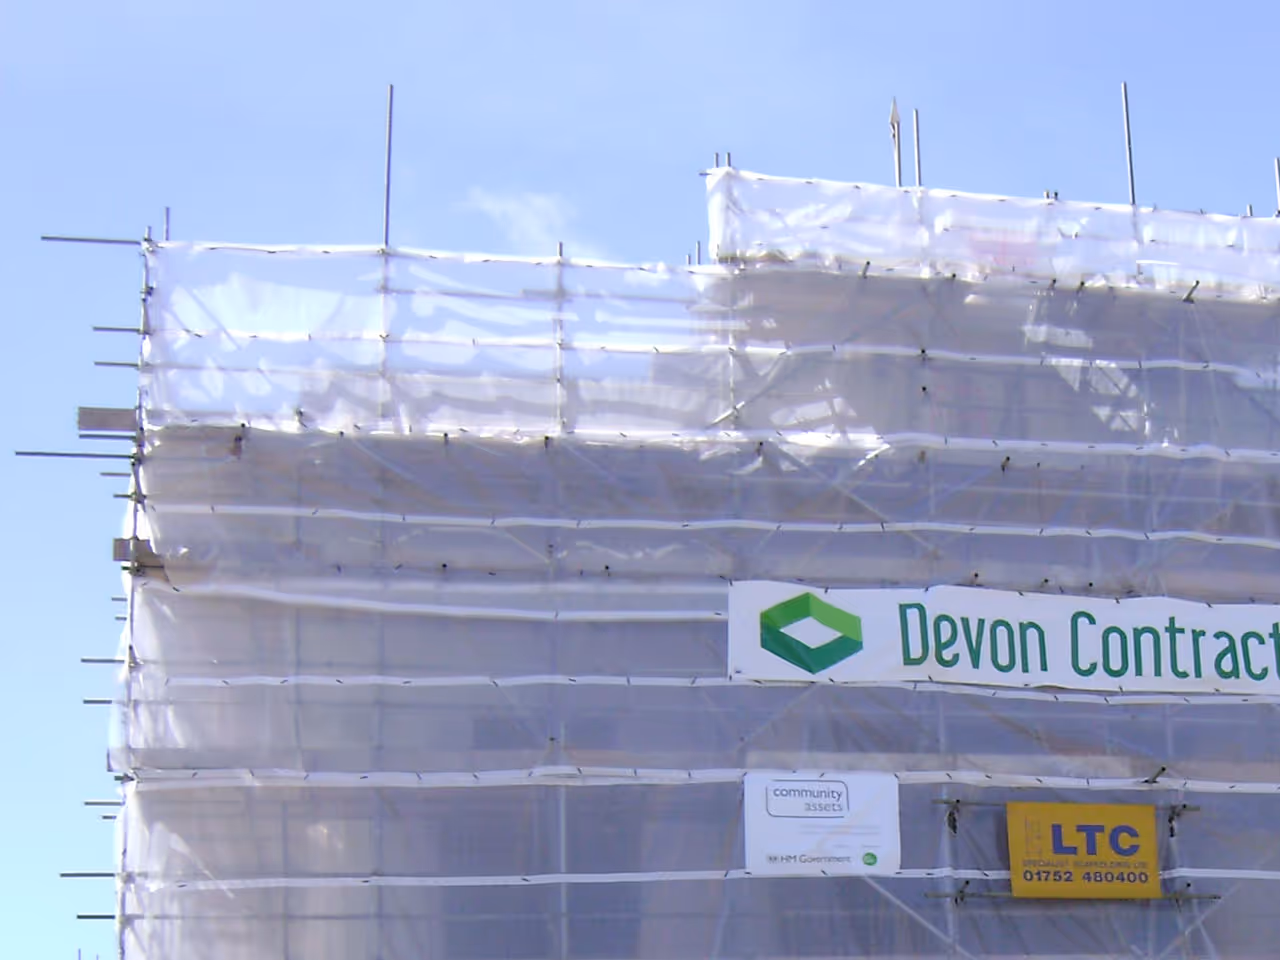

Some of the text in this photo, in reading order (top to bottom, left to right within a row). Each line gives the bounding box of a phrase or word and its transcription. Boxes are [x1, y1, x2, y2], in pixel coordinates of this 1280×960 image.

[898, 602, 1048, 673] Devon
[773, 787, 843, 802] community
[804, 802, 843, 812] assets
[1051, 823, 1140, 857] LTC
[1022, 870, 1149, 883] 01752 480400
